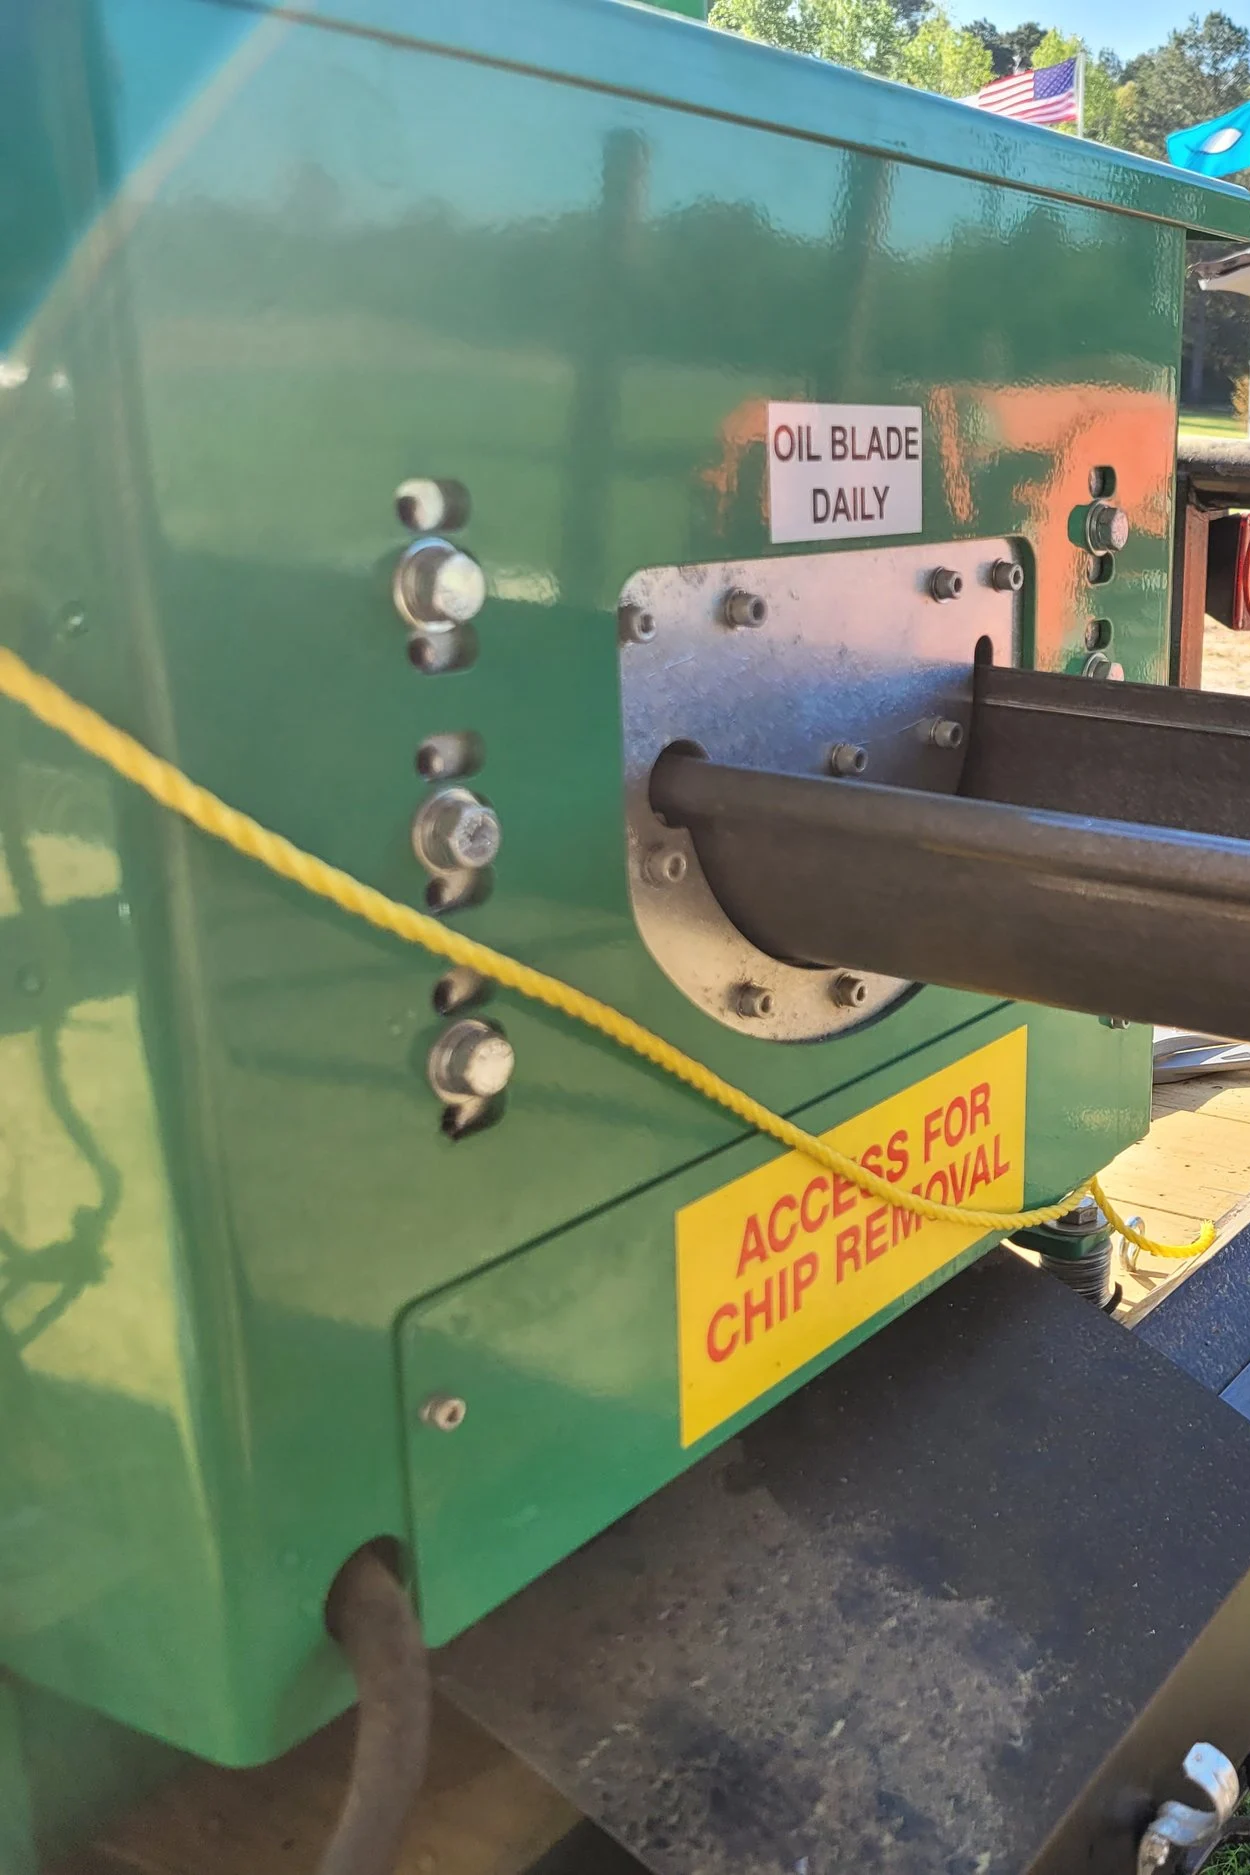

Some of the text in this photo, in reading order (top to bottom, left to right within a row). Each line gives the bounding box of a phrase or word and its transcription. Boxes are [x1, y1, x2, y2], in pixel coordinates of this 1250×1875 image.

[773, 424, 919, 462] OIL BLADE
[812, 486, 889, 524] DAILY
[736, 1082, 991, 1279] ACCESS FOR
[706, 1134, 1010, 1363] CHIP REMOVAL
